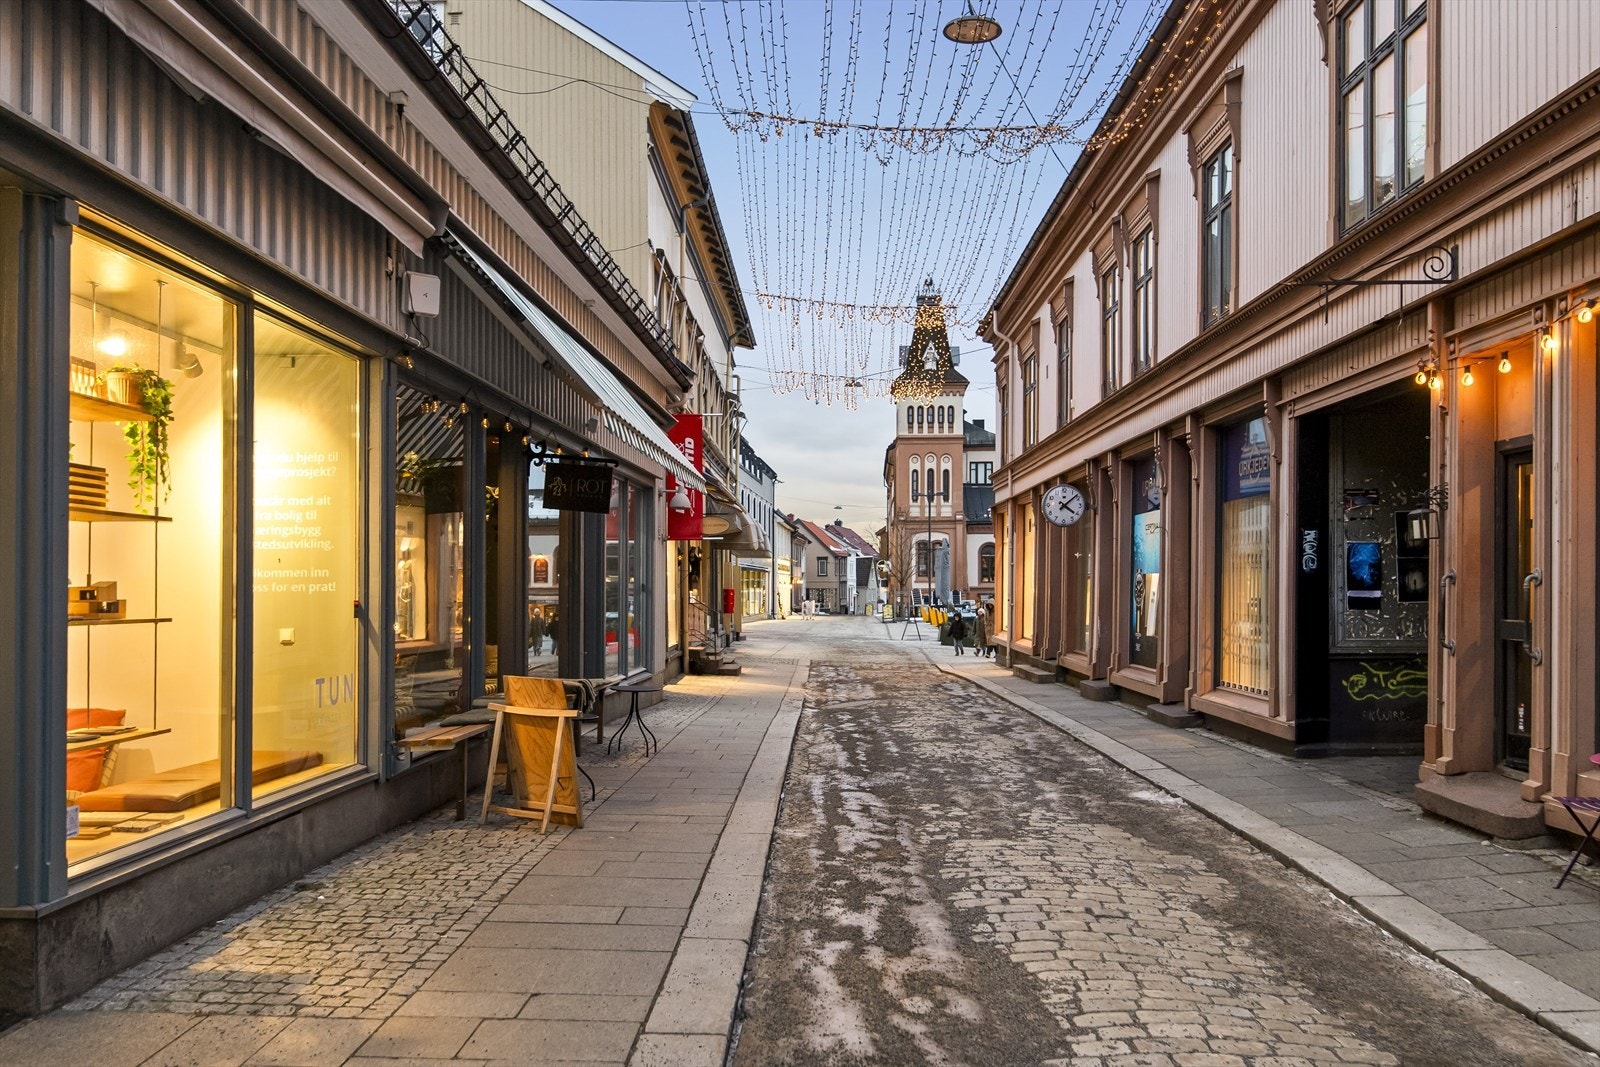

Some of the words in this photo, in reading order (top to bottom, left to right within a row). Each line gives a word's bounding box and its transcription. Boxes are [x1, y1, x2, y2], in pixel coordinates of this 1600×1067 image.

[296, 451, 325, 464] hjelp
[327, 451, 339, 462] til
[287, 496, 313, 506] med
[316, 496, 333, 506] alt
[274, 510, 303, 523] bolig
[305, 510, 317, 521] til
[254, 525, 322, 537] æringsbygg
[310, 568, 329, 578] inn
[271, 581, 287, 592] for
[291, 584, 306, 592] en
[308, 581, 337, 594] prat!
[315, 673, 353, 709] TUN
